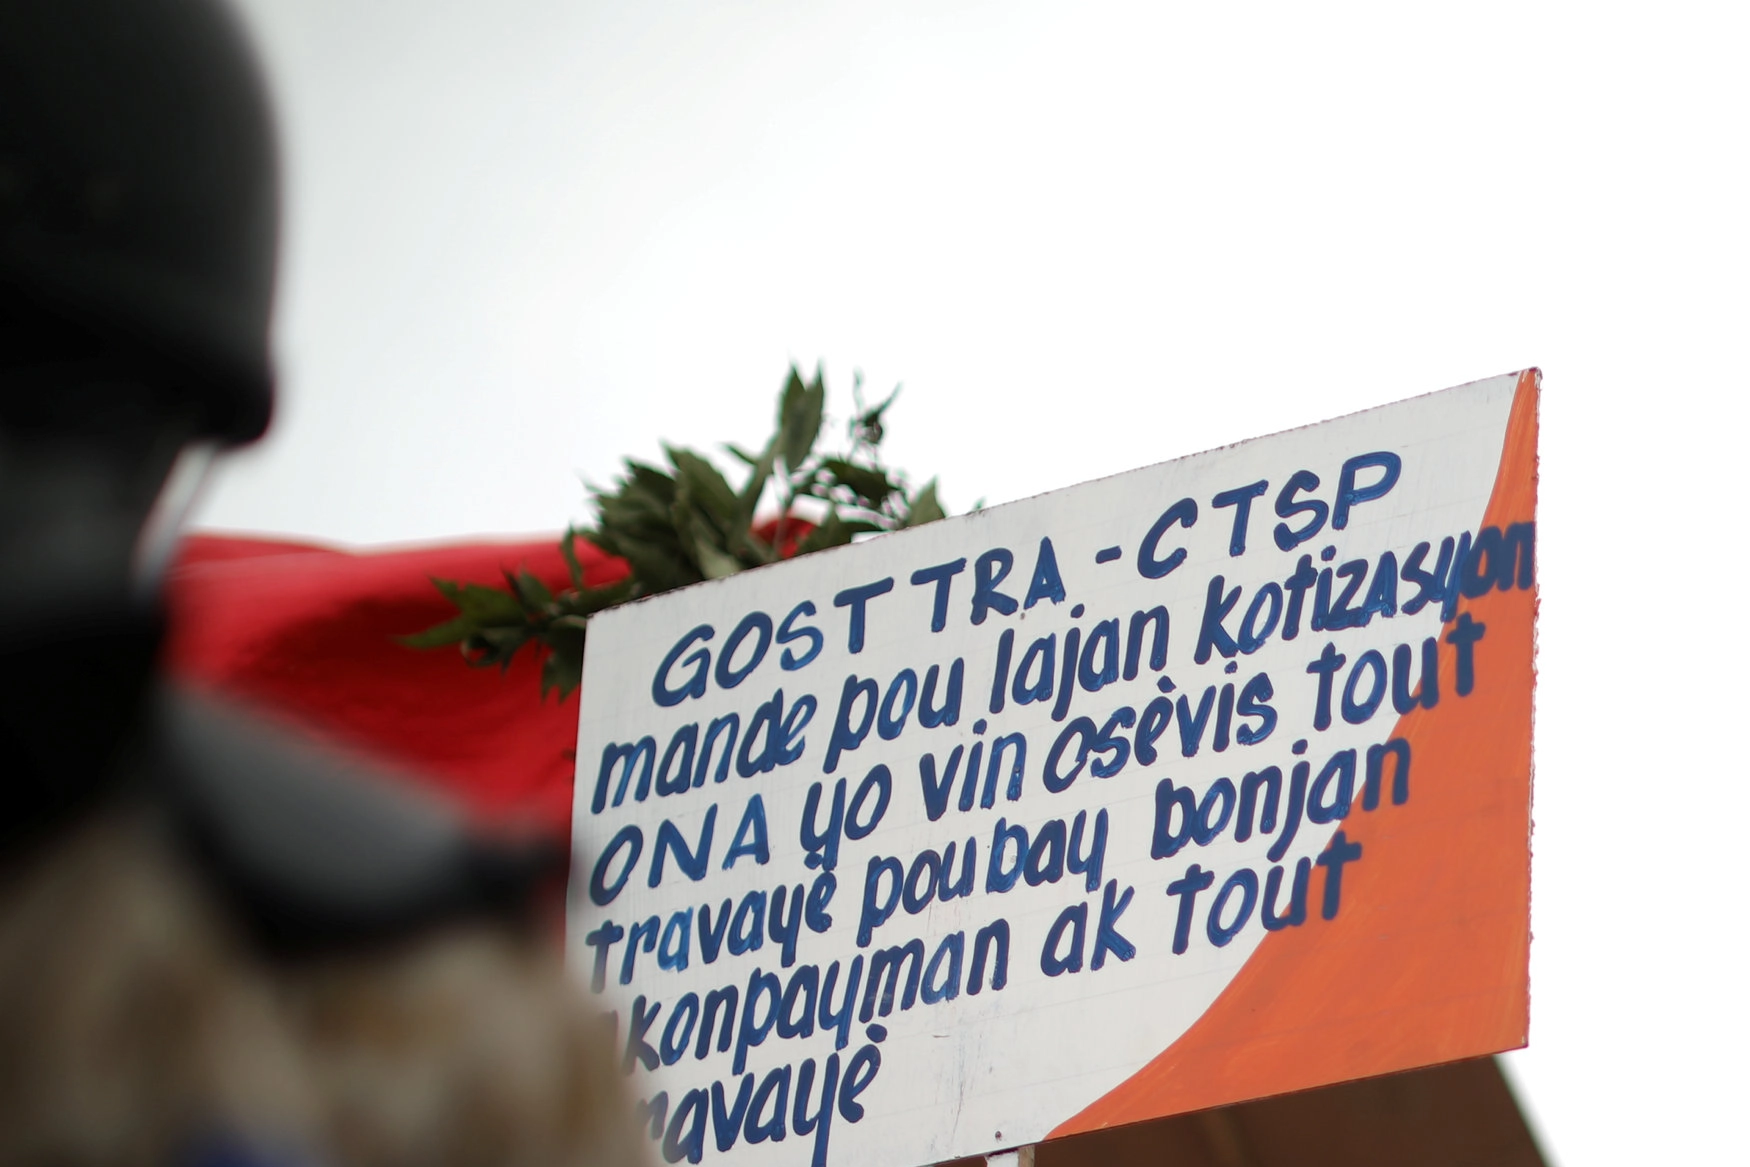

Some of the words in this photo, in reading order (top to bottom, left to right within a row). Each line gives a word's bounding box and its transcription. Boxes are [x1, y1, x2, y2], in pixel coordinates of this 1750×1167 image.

[591, 687, 818, 815] mande
[823, 657, 965, 775] pou
[989, 603, 1171, 724] lajan
[651, 576, 895, 708] GOST
[589, 794, 770, 906] ONA
[799, 763, 893, 870] yo
[918, 718, 1027, 821] vin
[1306, 611, 1486, 731] tout
[1151, 737, 1411, 863] bonjan
[603, 918, 1011, 1077] konpayman
[1040, 877, 1137, 977] ak
[1166, 831, 1363, 955] tout
